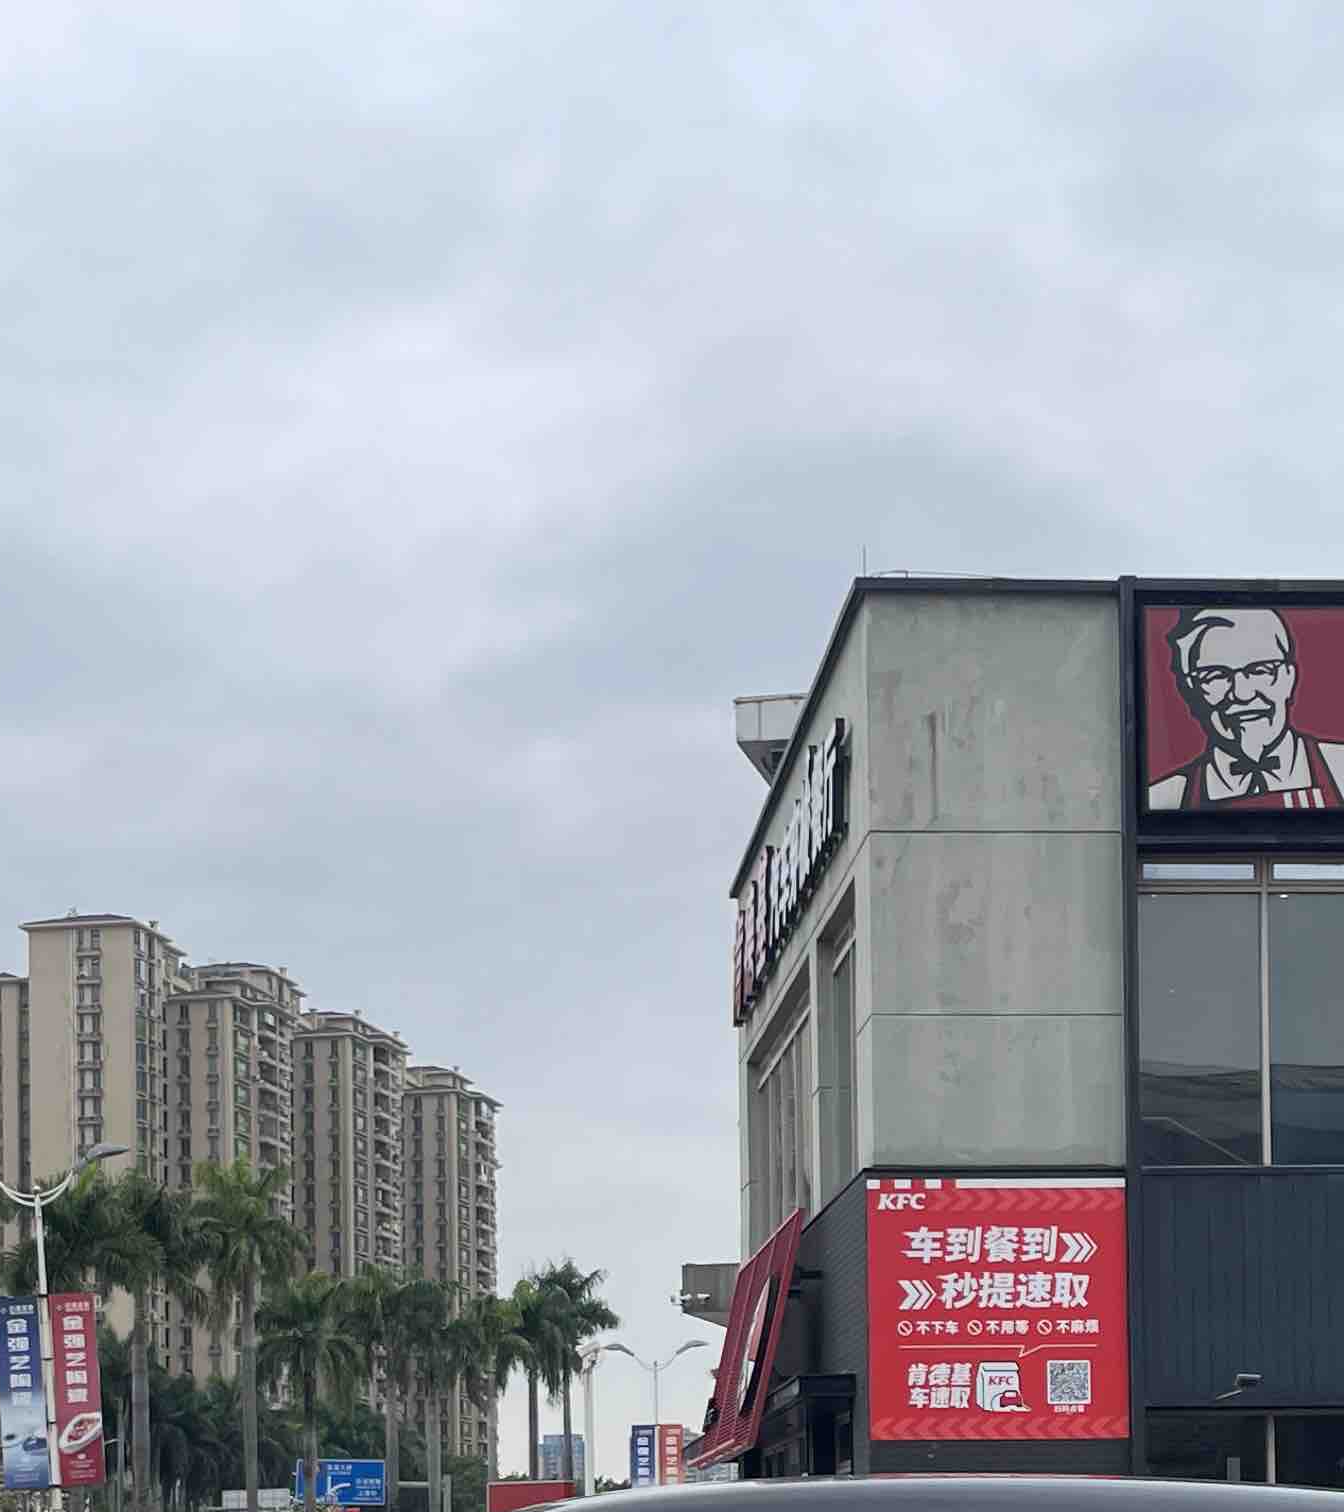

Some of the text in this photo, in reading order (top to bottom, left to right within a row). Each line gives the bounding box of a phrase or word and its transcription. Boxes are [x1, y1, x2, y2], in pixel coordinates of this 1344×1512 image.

[877, 1193, 926, 1210] KFC
[900, 1225, 1058, 1264] 车到餐到
[937, 1271, 1090, 1309] 秒提速取
[916, 1319, 960, 1335] 不下车
[985, 1319, 1030, 1335] 不用等
[907, 1362, 973, 1387] 肯德基
[988, 1374, 1015, 1386] KFC
